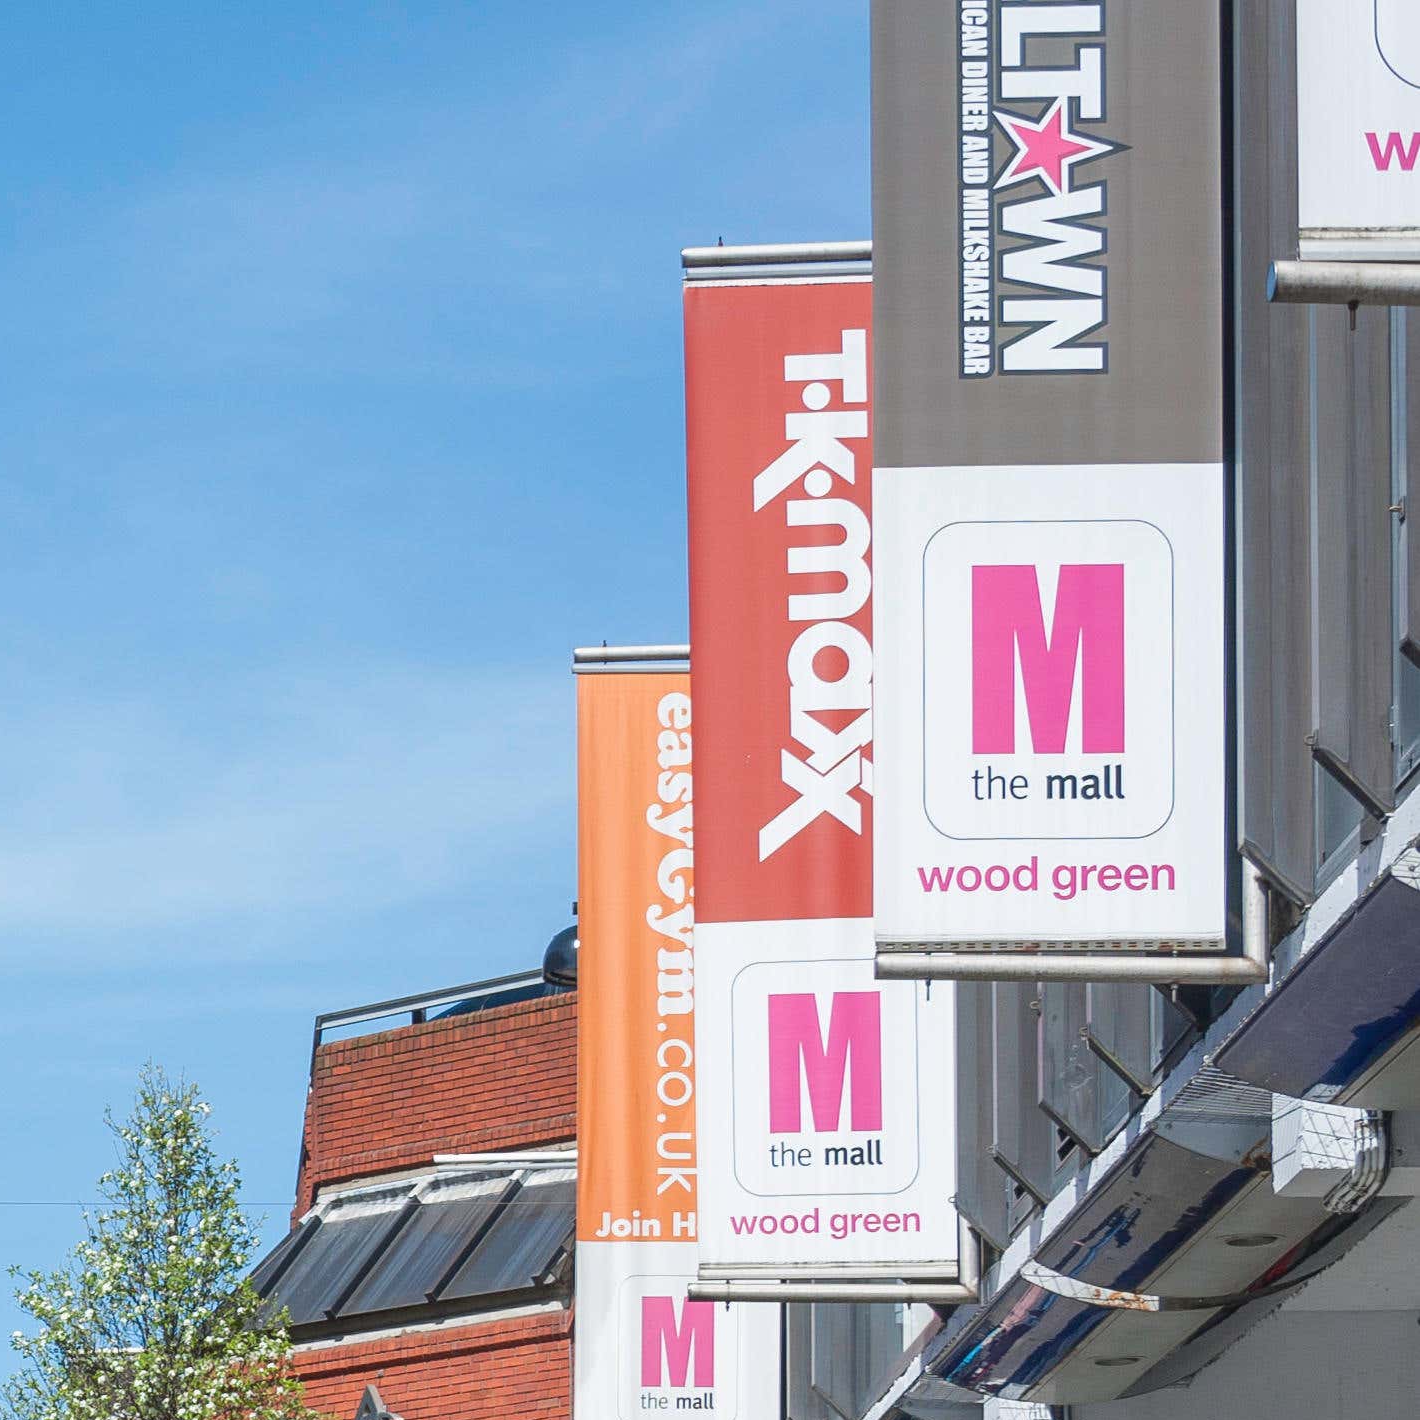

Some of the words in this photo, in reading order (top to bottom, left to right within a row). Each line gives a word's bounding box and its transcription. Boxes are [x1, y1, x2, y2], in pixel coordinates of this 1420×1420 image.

[962, 62, 988, 131] DINER
[962, 135, 989, 184] AND
[961, 188, 990, 320] MILKSHAKE
[962, 323, 990, 374] BAR
[972, 565, 1125, 754] M
[972, 766, 1029, 801] the
[1045, 765, 1125, 800] mall
[917, 856, 1039, 892] wood
[1052, 861, 1177, 900] green
[768, 991, 883, 1133] M
[770, 1142, 812, 1168] the
[824, 1139, 883, 1166] mall
[595, 1211, 661, 1237] Join
[730, 1208, 820, 1235] wood
[830, 1211, 921, 1239] green
[641, 1296, 715, 1387] M
[640, 1393, 668, 1410] the
[675, 1393, 714, 1410] mall
